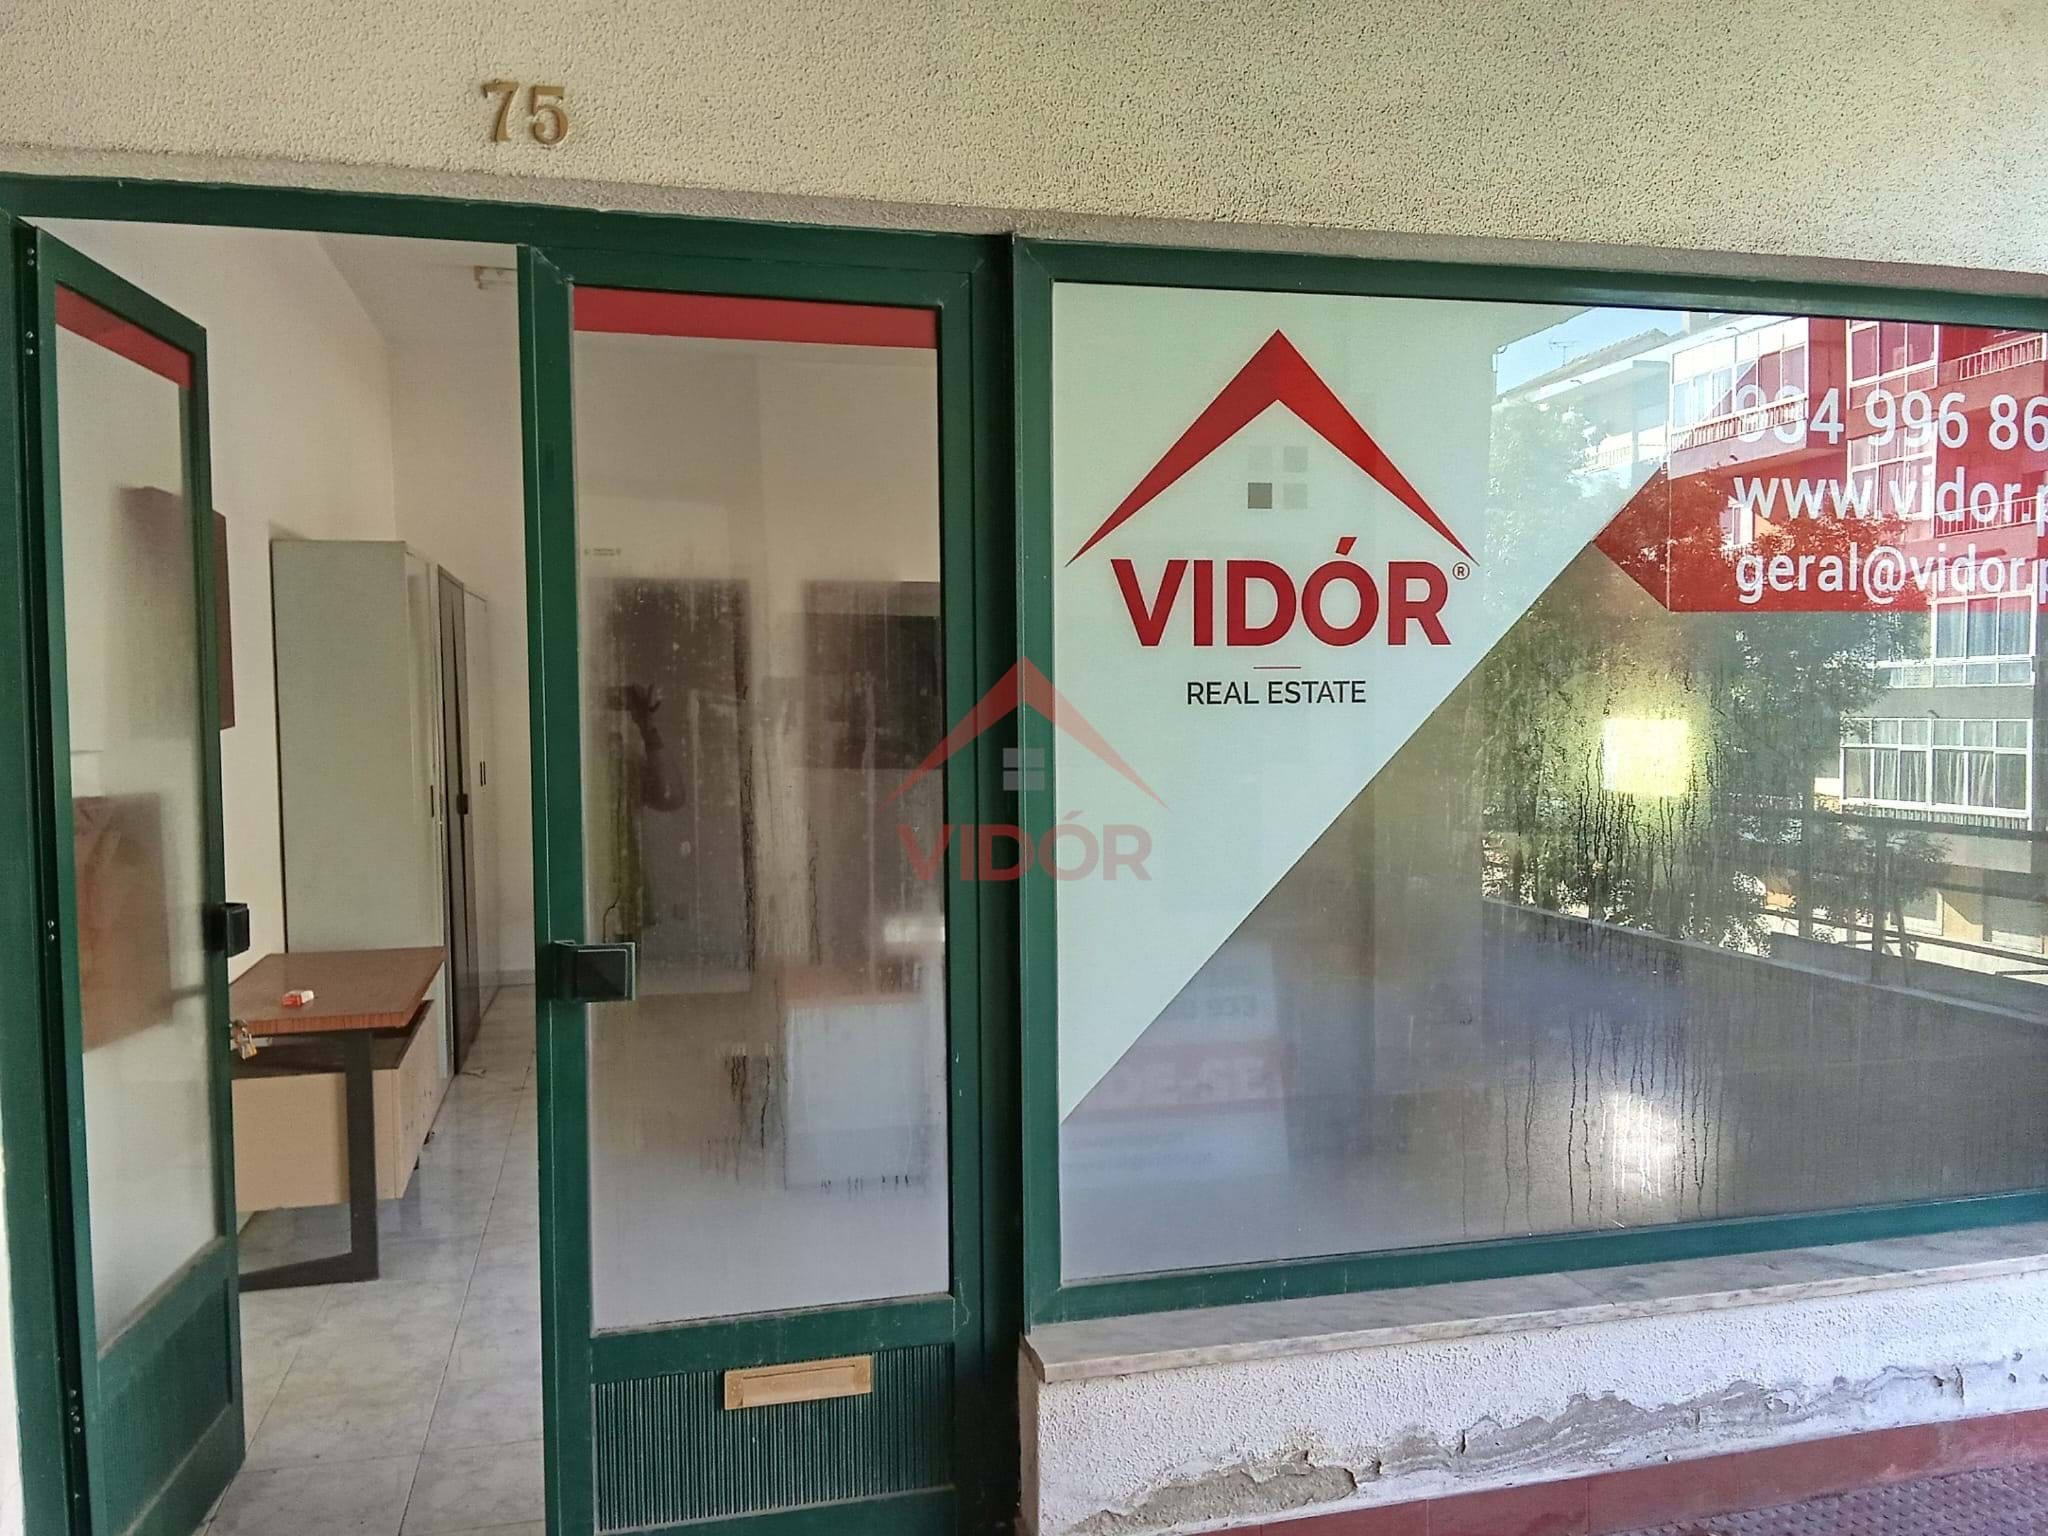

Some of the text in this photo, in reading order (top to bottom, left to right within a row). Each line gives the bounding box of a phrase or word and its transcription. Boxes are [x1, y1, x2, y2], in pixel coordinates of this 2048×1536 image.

[481, 79, 569, 146] 75
[1865, 389, 1969, 449] 996
[1187, 680, 1367, 705] REAL ESTATE
